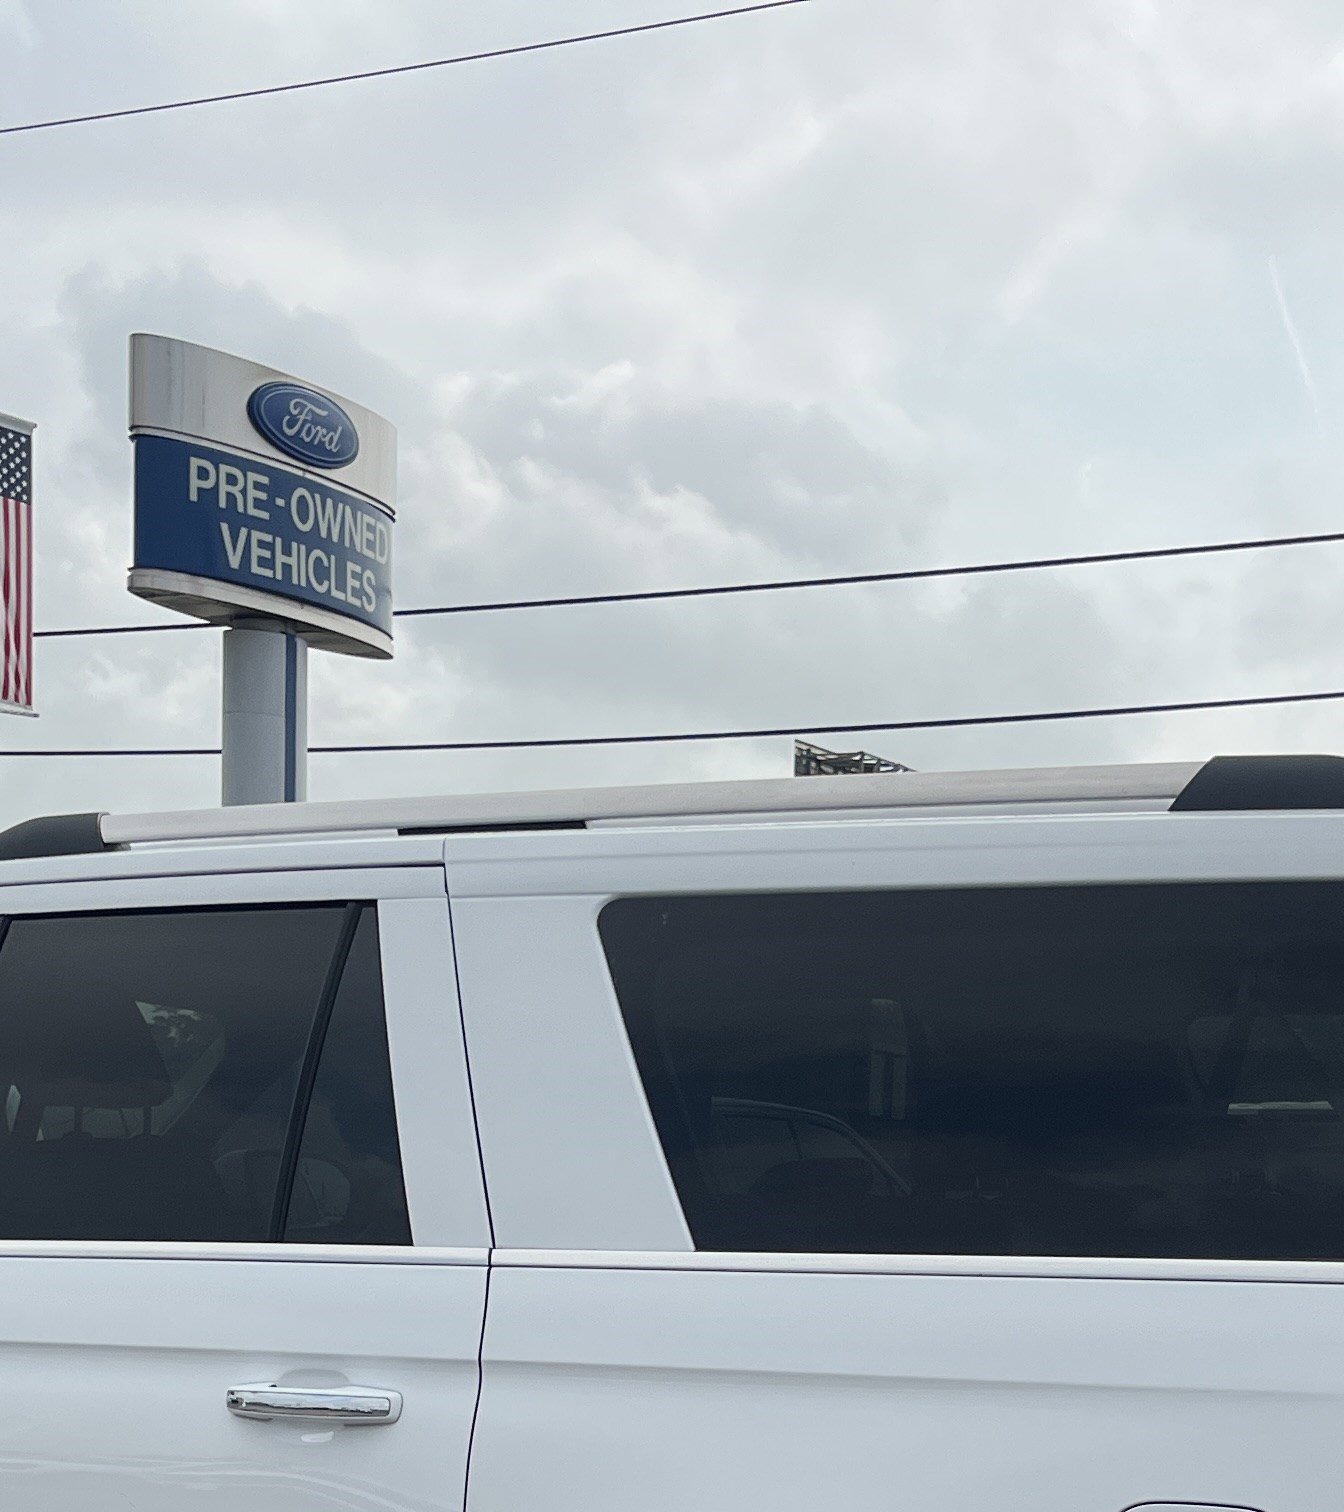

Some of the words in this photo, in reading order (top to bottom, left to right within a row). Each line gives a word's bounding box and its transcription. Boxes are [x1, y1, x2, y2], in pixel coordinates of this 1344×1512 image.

[282, 398, 343, 453] Ford
[188, 456, 388, 566] PRE-OWNED
[219, 522, 377, 614] VEHICLES
